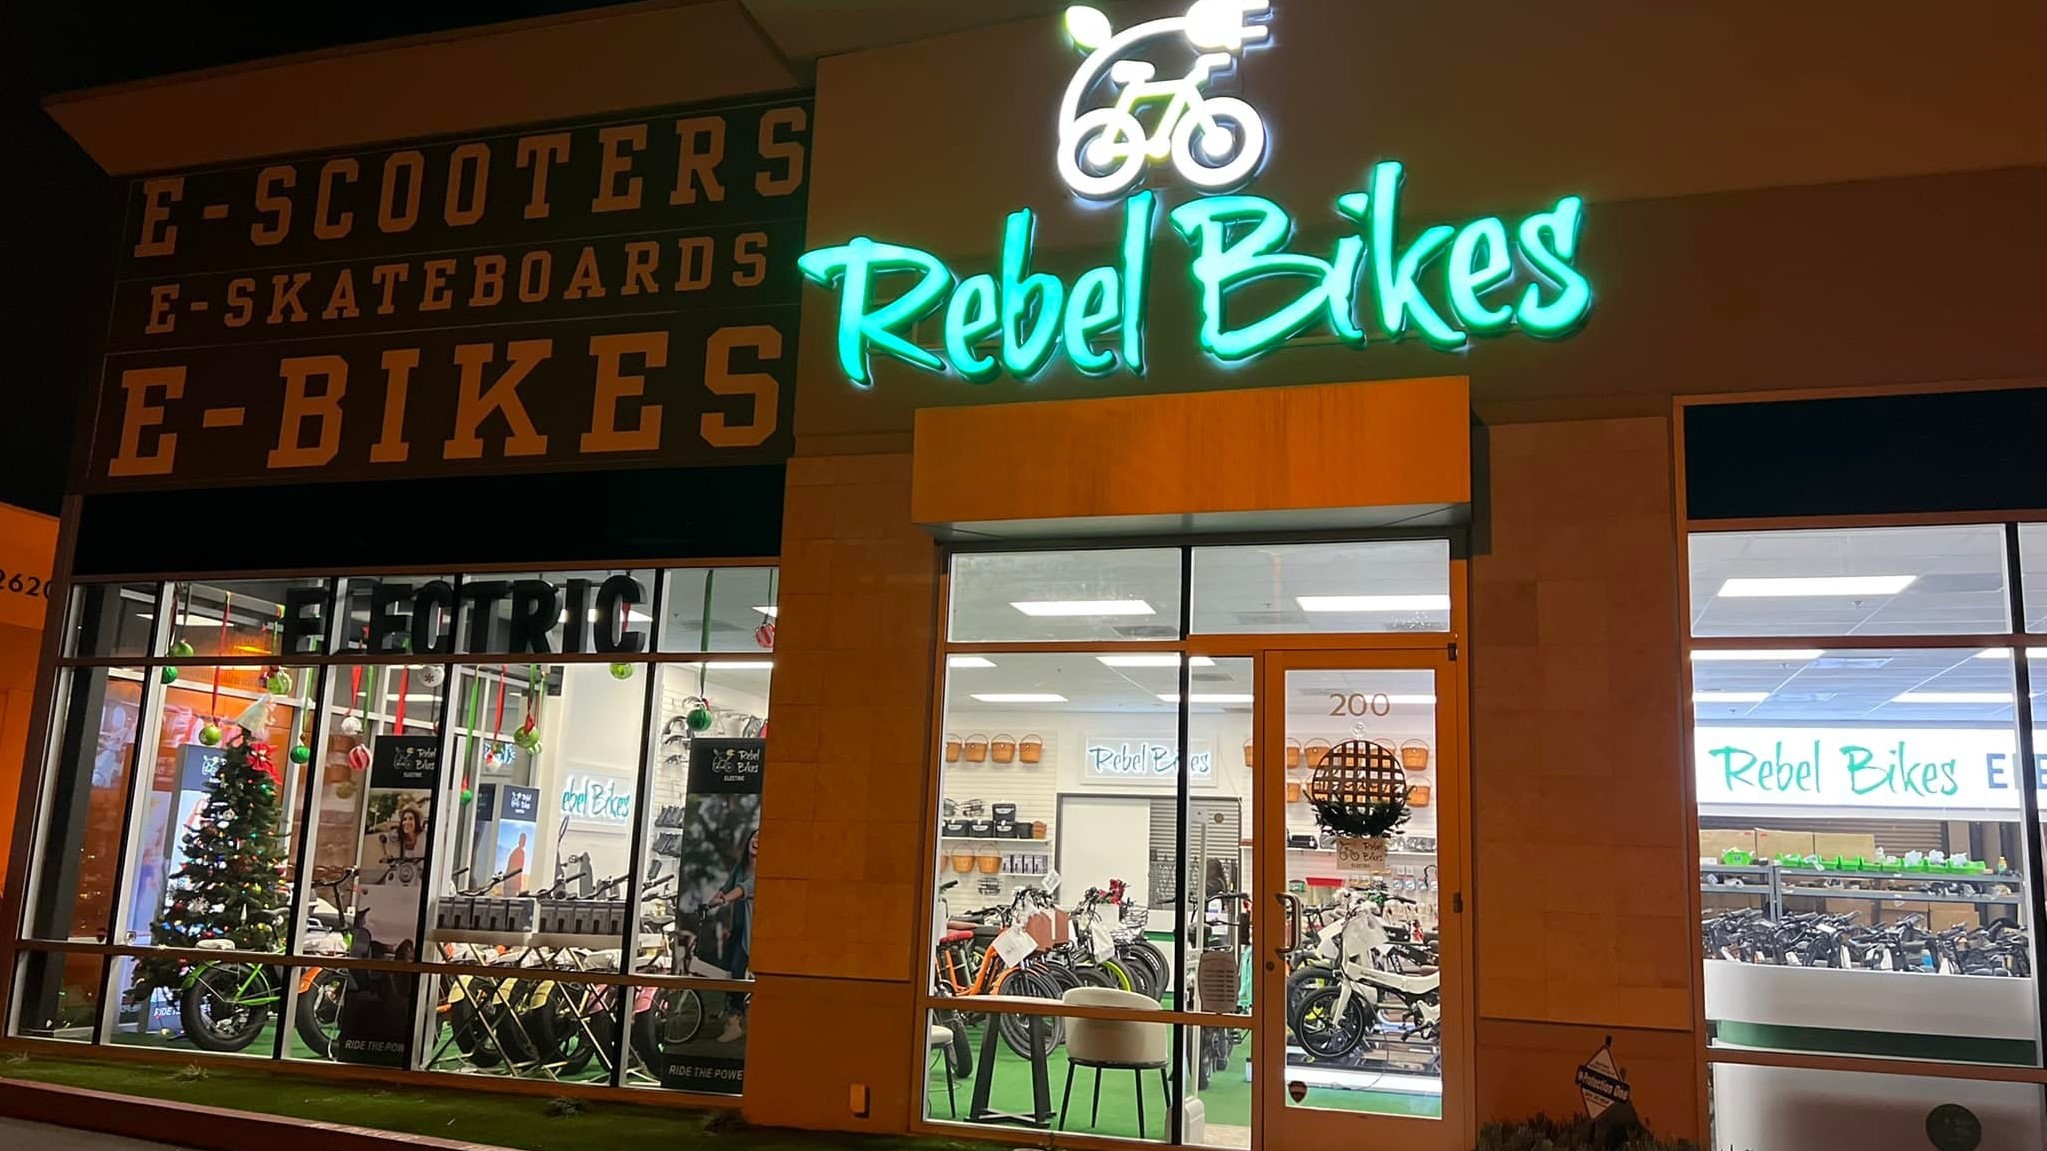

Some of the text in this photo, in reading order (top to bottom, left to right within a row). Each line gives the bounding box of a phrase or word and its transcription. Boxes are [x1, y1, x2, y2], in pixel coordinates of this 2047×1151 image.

[134, 107, 807, 257] E-SCOOTERS
[144, 232, 768, 334] E-SKATEBOARDS
[797, 160, 1594, 386] Rebel Bikes
[108, 324, 783, 477] E-BIKES
[283, 574, 646, 653] EECTRIC
[1329, 692, 1390, 716] 200
[1088, 744, 1209, 773] Rebel Bies
[1708, 740, 2047, 797] Rebel Bikes EE
[561, 777, 590, 815] ebel
[592, 781, 630, 818] Bikes
[345, 1039, 366, 1050] RIDE
[367, 1041, 384, 1051] THE
[670, 1064, 692, 1077] RIDE
[694, 1066, 713, 1078] THE
